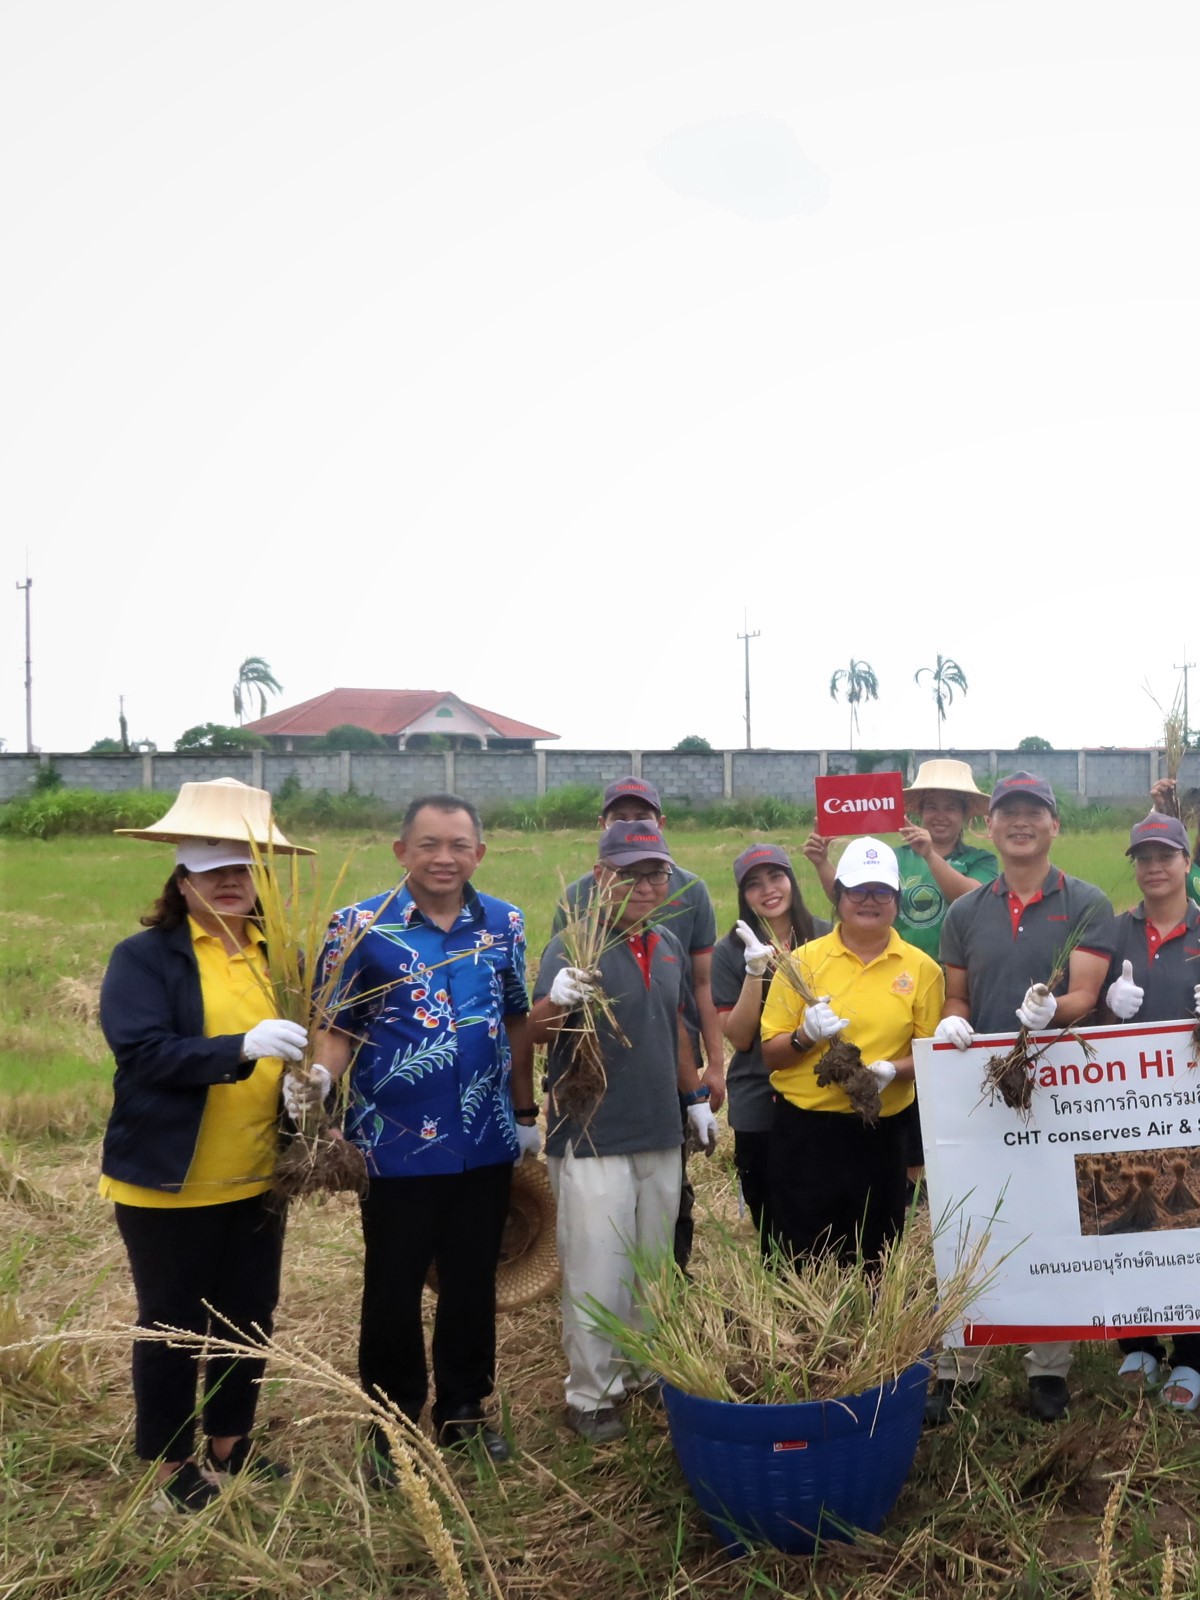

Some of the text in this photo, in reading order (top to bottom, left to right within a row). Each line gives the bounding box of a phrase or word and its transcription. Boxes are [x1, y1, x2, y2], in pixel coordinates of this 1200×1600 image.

[823, 796, 895, 814] Canon
[1023, 1058, 1127, 1088] anon
[1139, 1049, 1175, 1079] Hi
[1003, 1130, 1041, 1147] CHT
[1047, 1125, 1141, 1144] conserves
[1147, 1120, 1173, 1137] Air
[1179, 1118, 1192, 1134] &
